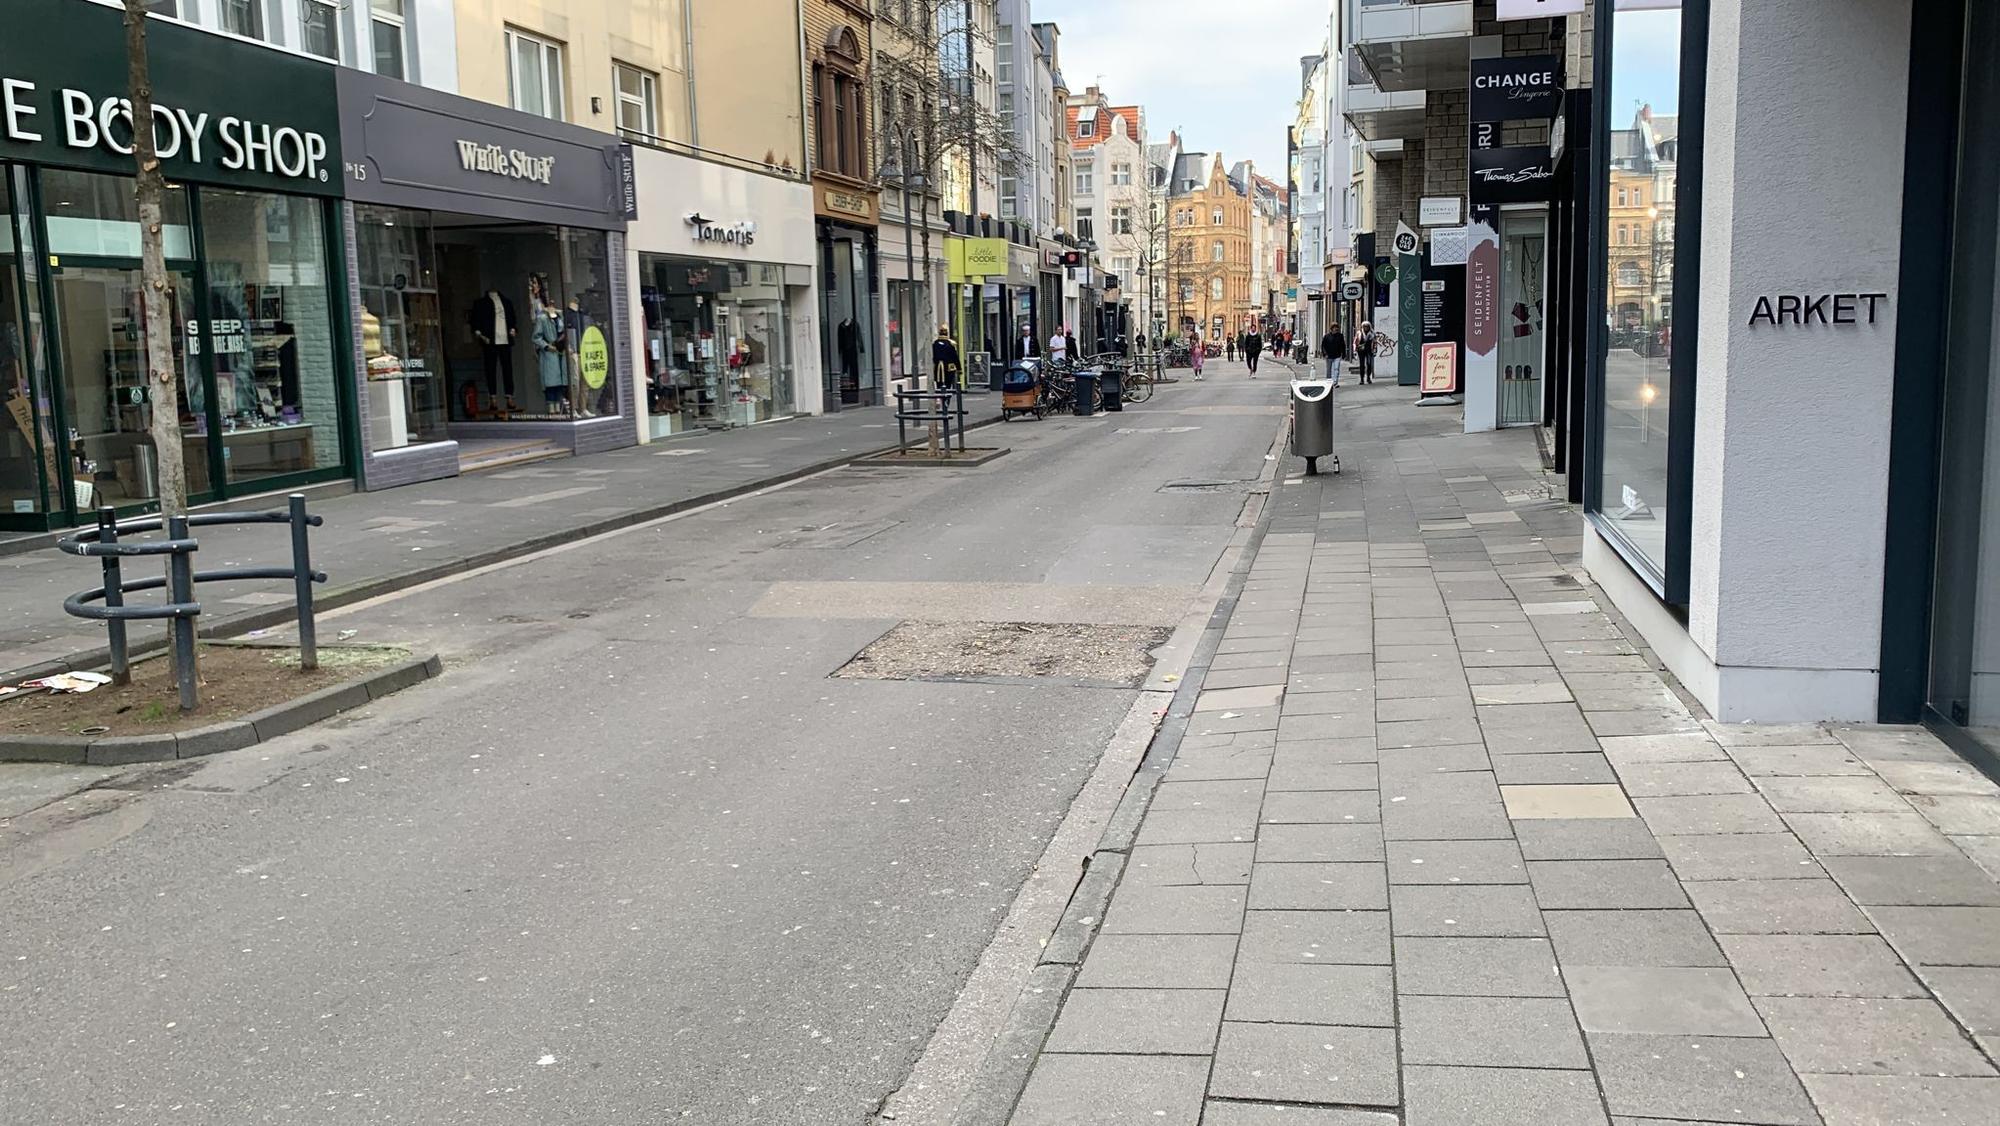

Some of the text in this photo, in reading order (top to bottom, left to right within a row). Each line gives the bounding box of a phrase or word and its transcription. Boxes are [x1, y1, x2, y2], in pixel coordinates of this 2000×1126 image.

[1475, 72, 1552, 88] CHANGE
[1508, 87, 1551, 102] Lingerie
[62, 88, 208, 163] BODY
[1475, 166, 1553, 183] Thomas Sabo
[690, 213, 754, 246] Tamaris
[968, 255, 997, 263] FOODIE
[1474, 261, 1484, 335] SEIDENFELT
[1749, 293, 1887, 325] ARKET
[187, 319, 245, 334] SEEP.
[1428, 352, 1450, 361] Nails
